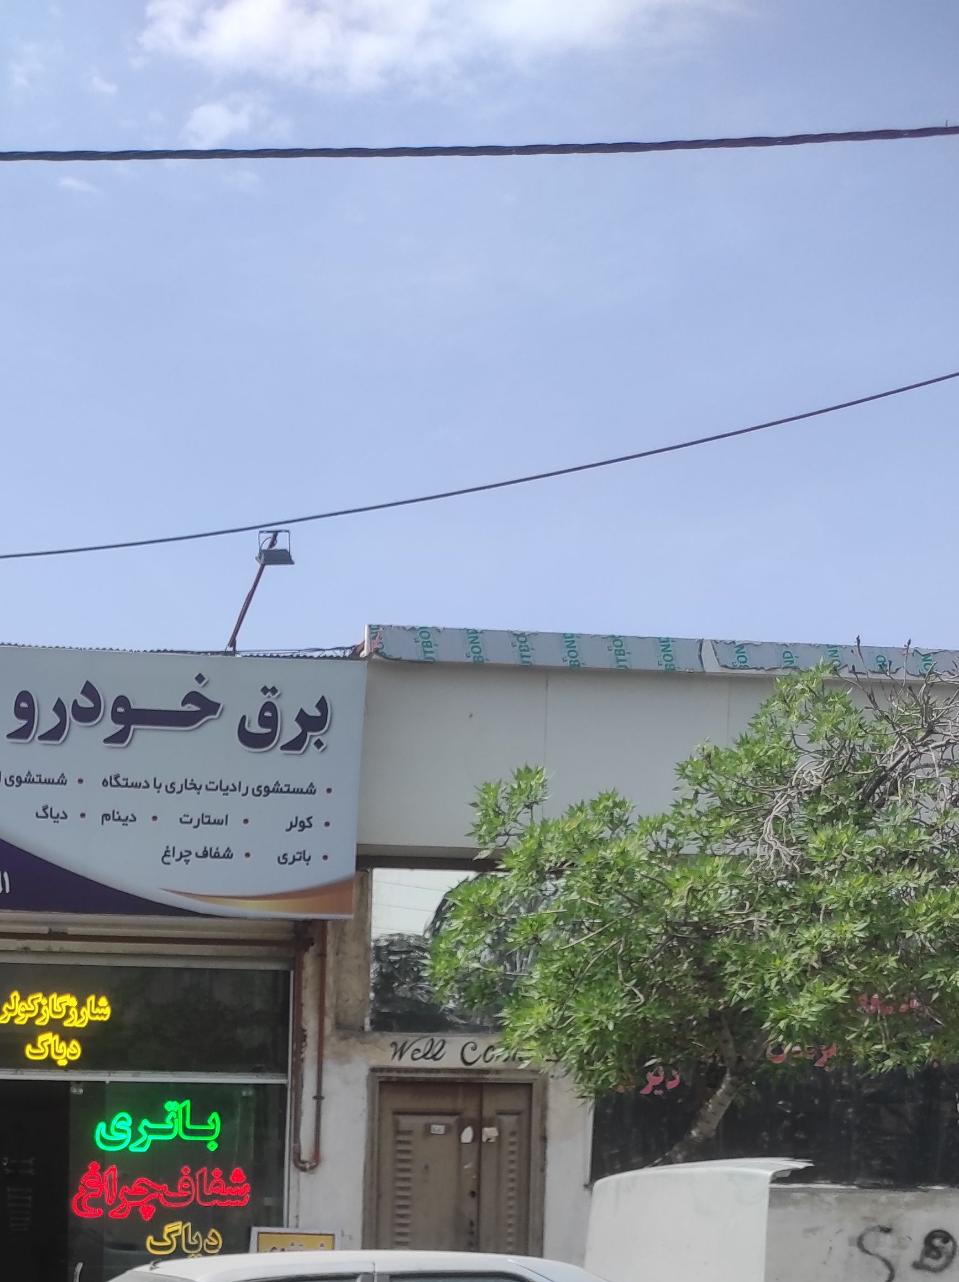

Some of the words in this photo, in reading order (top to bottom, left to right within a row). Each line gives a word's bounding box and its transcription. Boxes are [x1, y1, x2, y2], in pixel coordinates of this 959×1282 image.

[5, 672, 224, 746] خودرو
[237, 685, 331, 754] برق
[4, 771, 68, 787] شستشوی
[101, 773, 150, 790] دستگاه
[153, 777, 162, 791] با
[165, 778, 202, 794] بخاری
[205, 778, 248, 796] رادیات
[251, 781, 317, 797] شستشوی
[35, 805, 68, 823] دیاگ
[101, 810, 137, 825] دینام
[179, 812, 229, 828] استارت
[286, 816, 313, 832] کولر
[161, 845, 192, 864] چراغ
[195, 846, 234, 860] شفاف
[277, 850, 312, 866] باتری
[25, 1031, 81, 1066] دیاگ
[390, 1036, 445, 1062] Well
[95, 1099, 221, 1152] باتری
[72, 1160, 163, 1221] چراغ
[159, 1165, 251, 1208] شفاف
[146, 1221, 223, 1257] دیاگ
